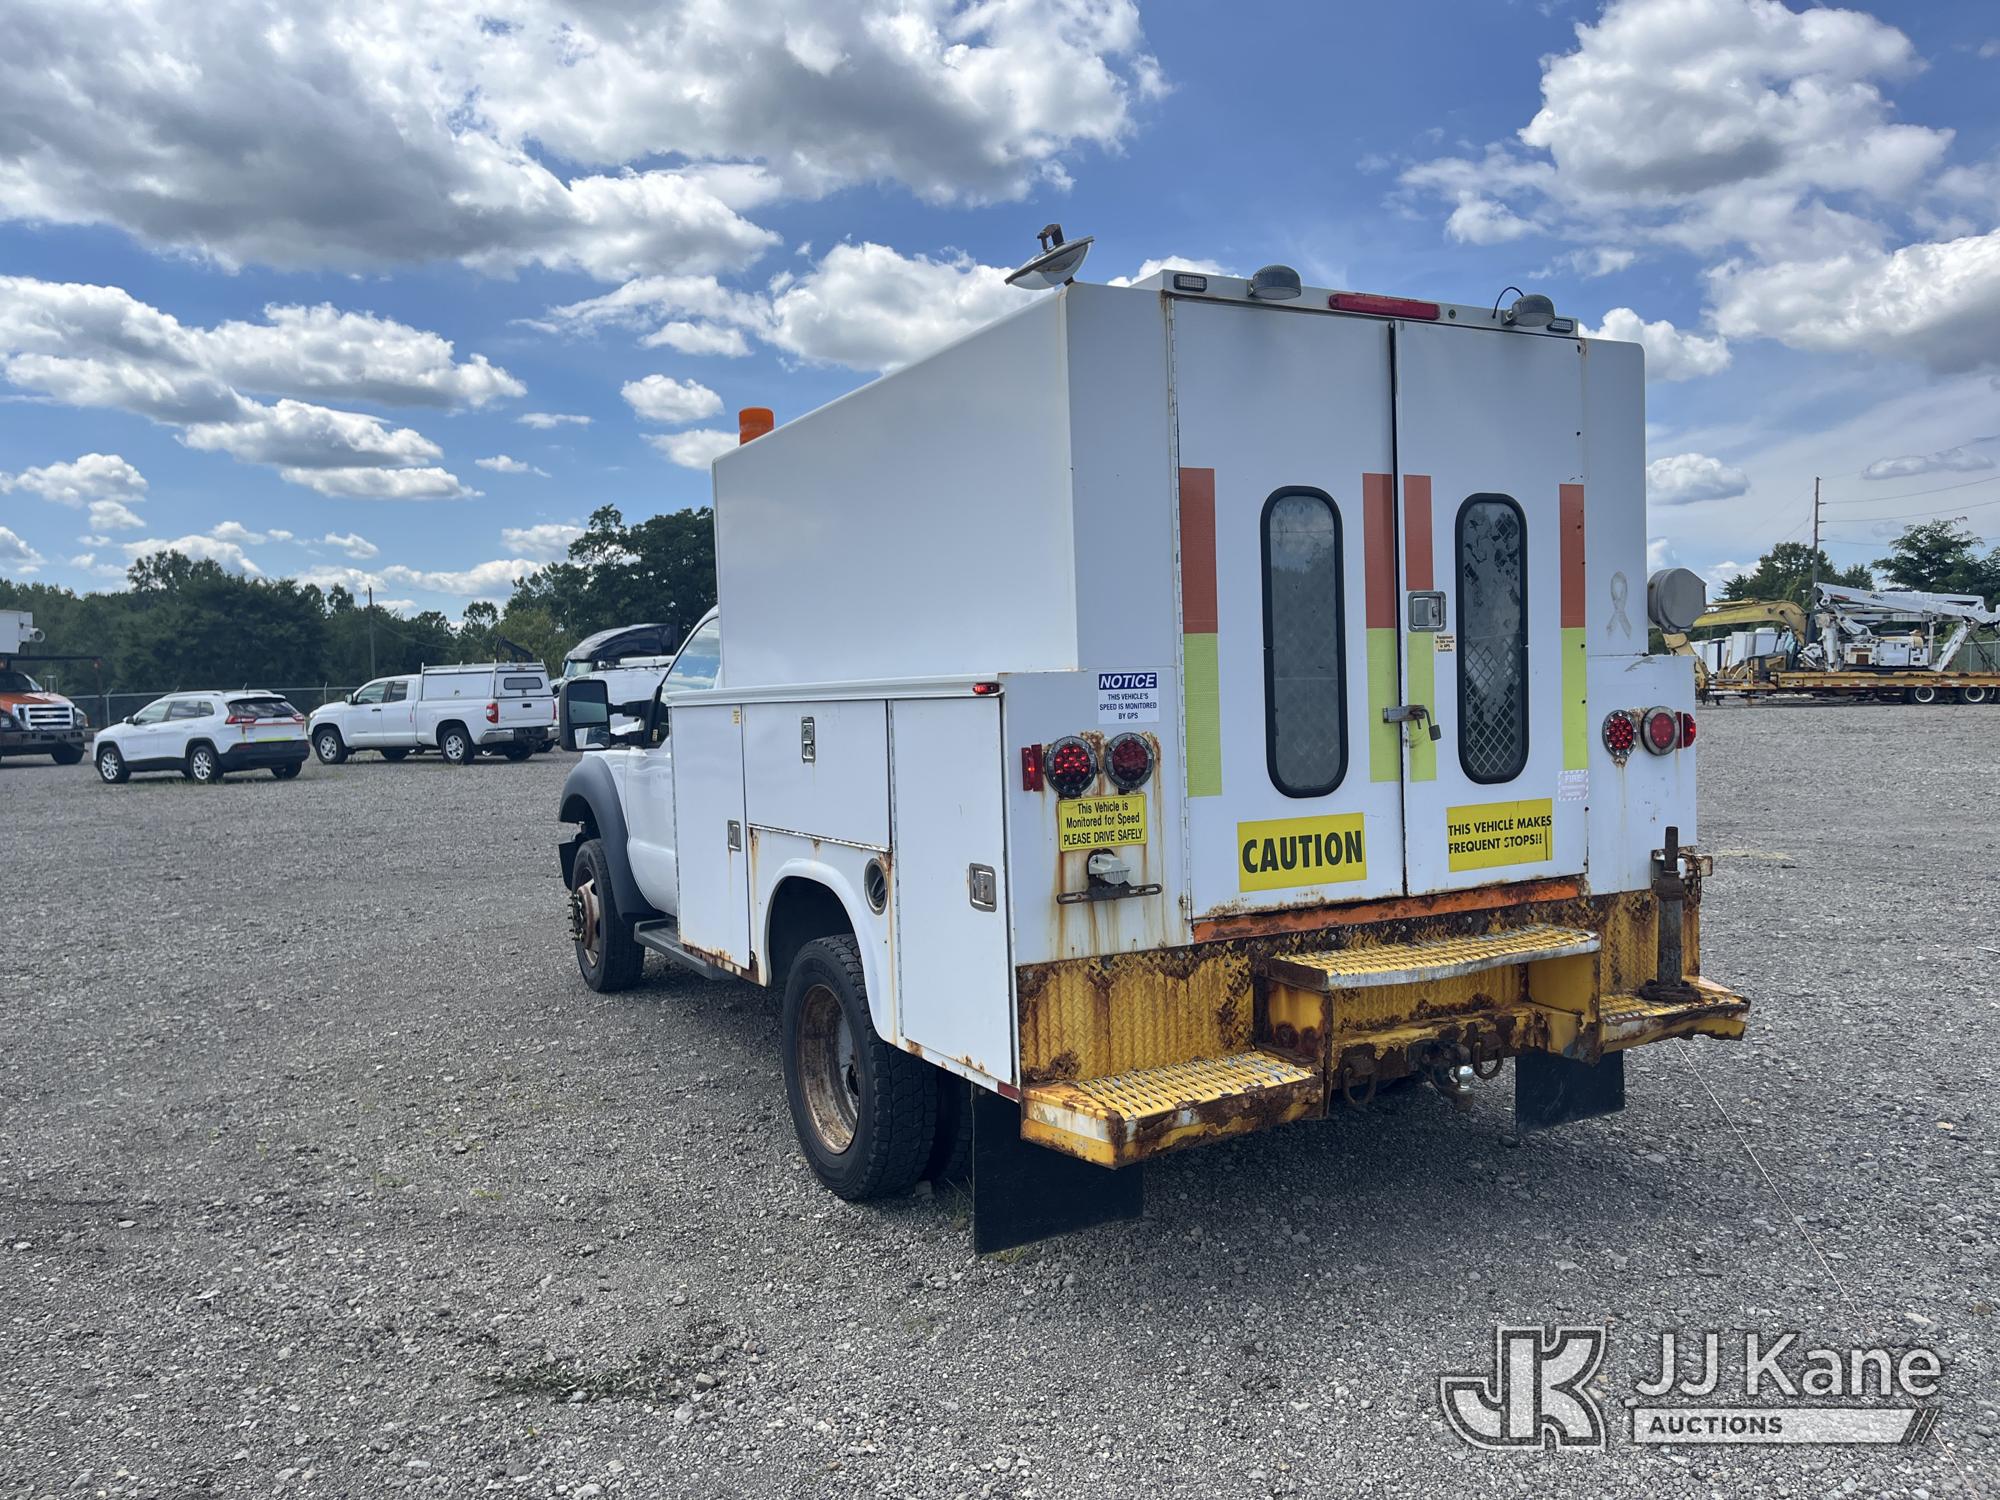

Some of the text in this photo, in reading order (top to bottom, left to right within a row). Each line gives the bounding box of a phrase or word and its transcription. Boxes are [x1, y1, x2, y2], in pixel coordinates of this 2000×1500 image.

[1100, 674, 1156, 688] NOTICE
[1078, 800, 1128, 814] This Vehicle is
[1066, 812, 1139, 828] Monitored for Speed
[1448, 815, 1552, 836] THIS VEHICLE MAKES
[1064, 828, 1142, 845] PLEASE DRIVE SAFELY
[1448, 833, 1542, 854] FREQUENT STOPS!!
[1242, 830, 1362, 874] CAUTION
